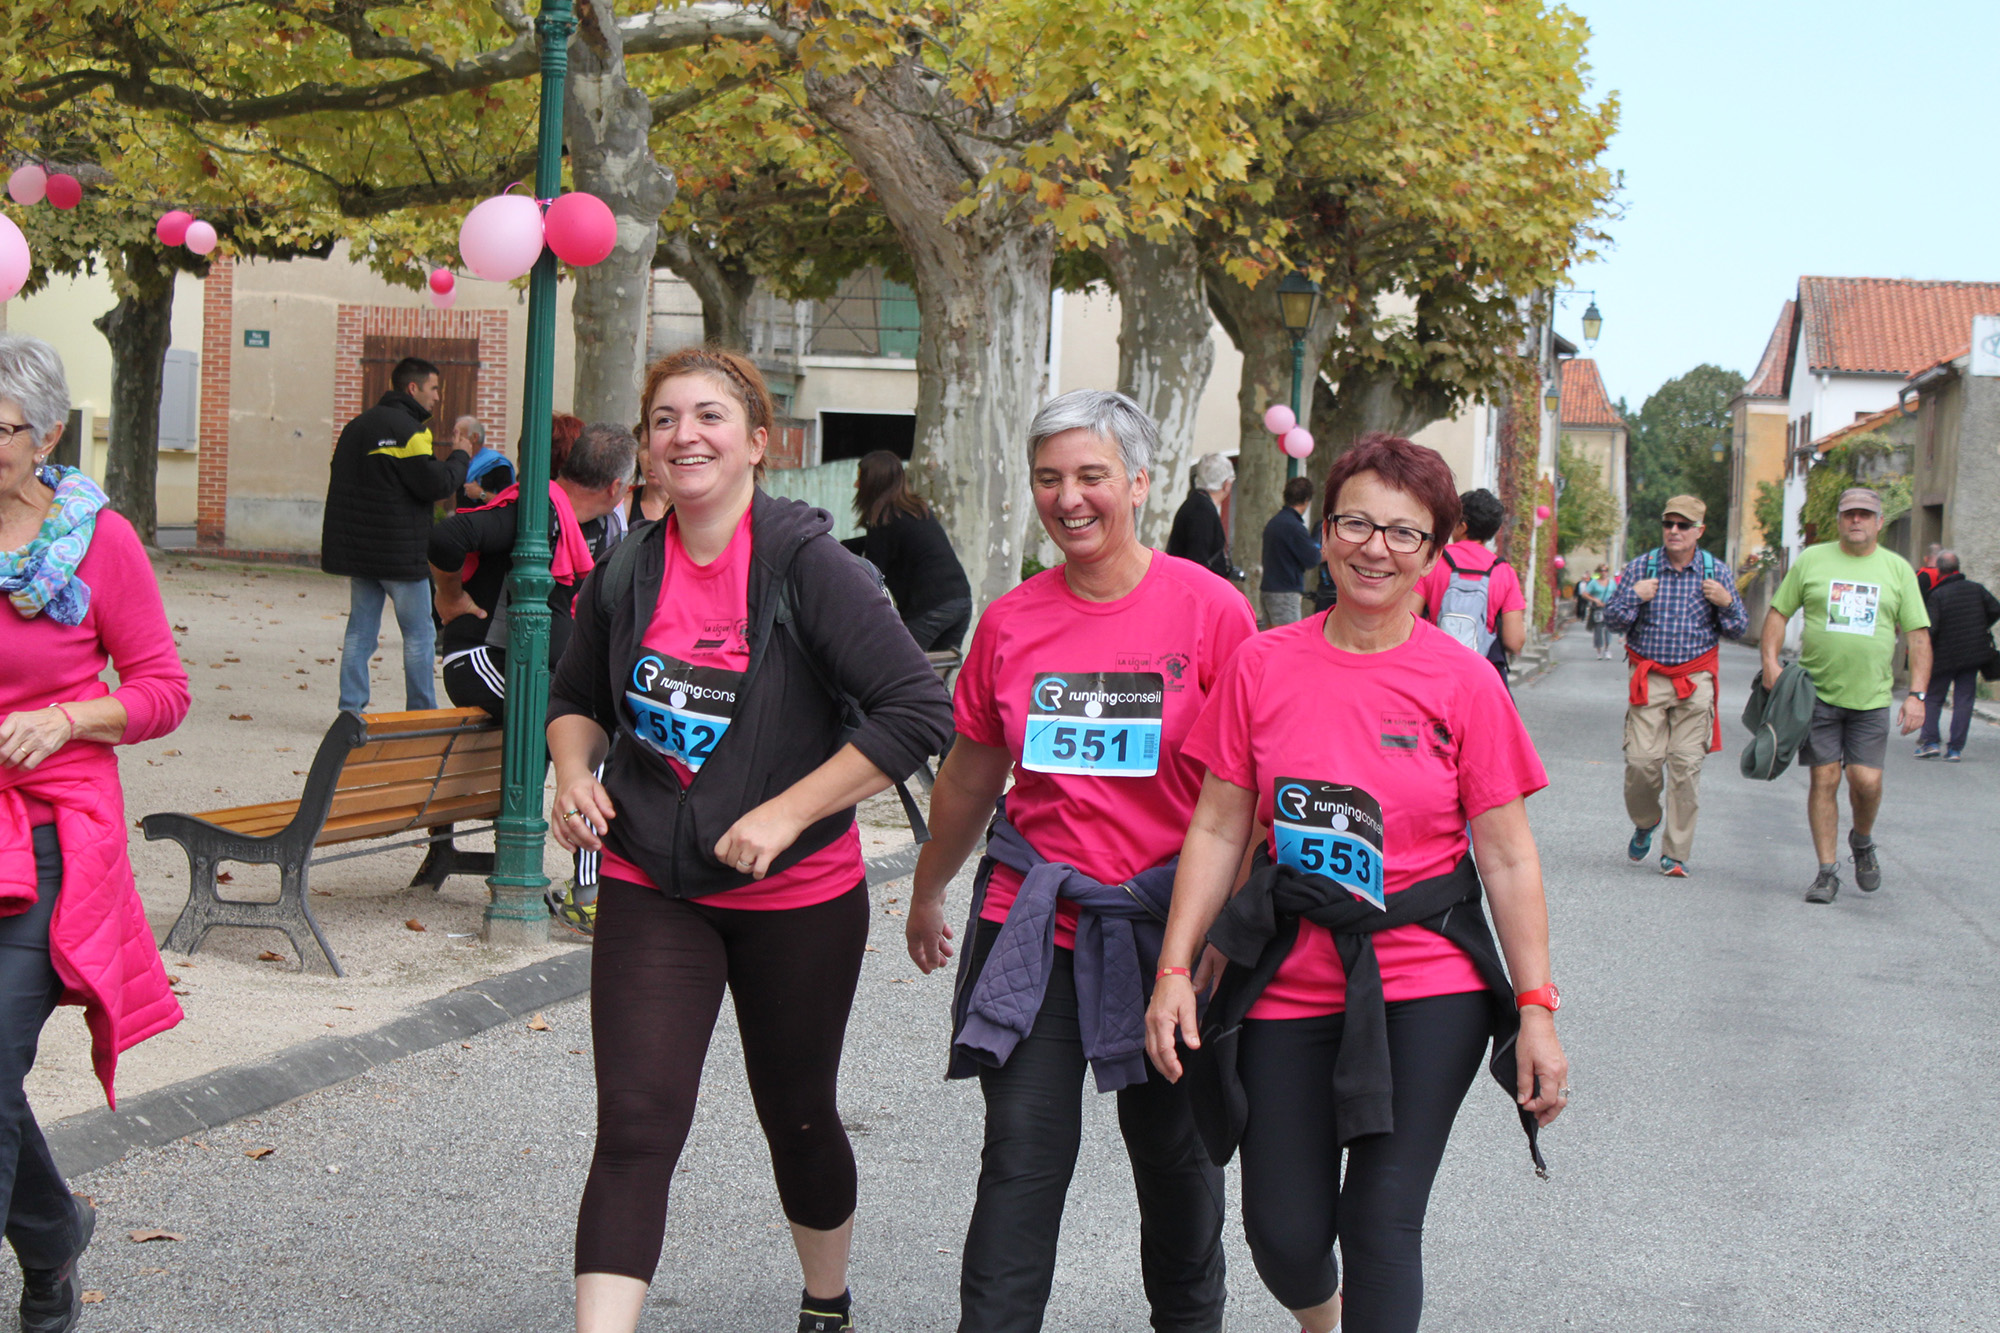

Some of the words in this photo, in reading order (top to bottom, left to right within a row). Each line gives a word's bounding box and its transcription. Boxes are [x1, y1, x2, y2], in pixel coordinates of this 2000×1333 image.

[1069, 690, 1161, 706] runningconseil
[648, 710, 715, 759] 552
[1052, 727, 1128, 762] 551
[1299, 837, 1371, 884] 553
